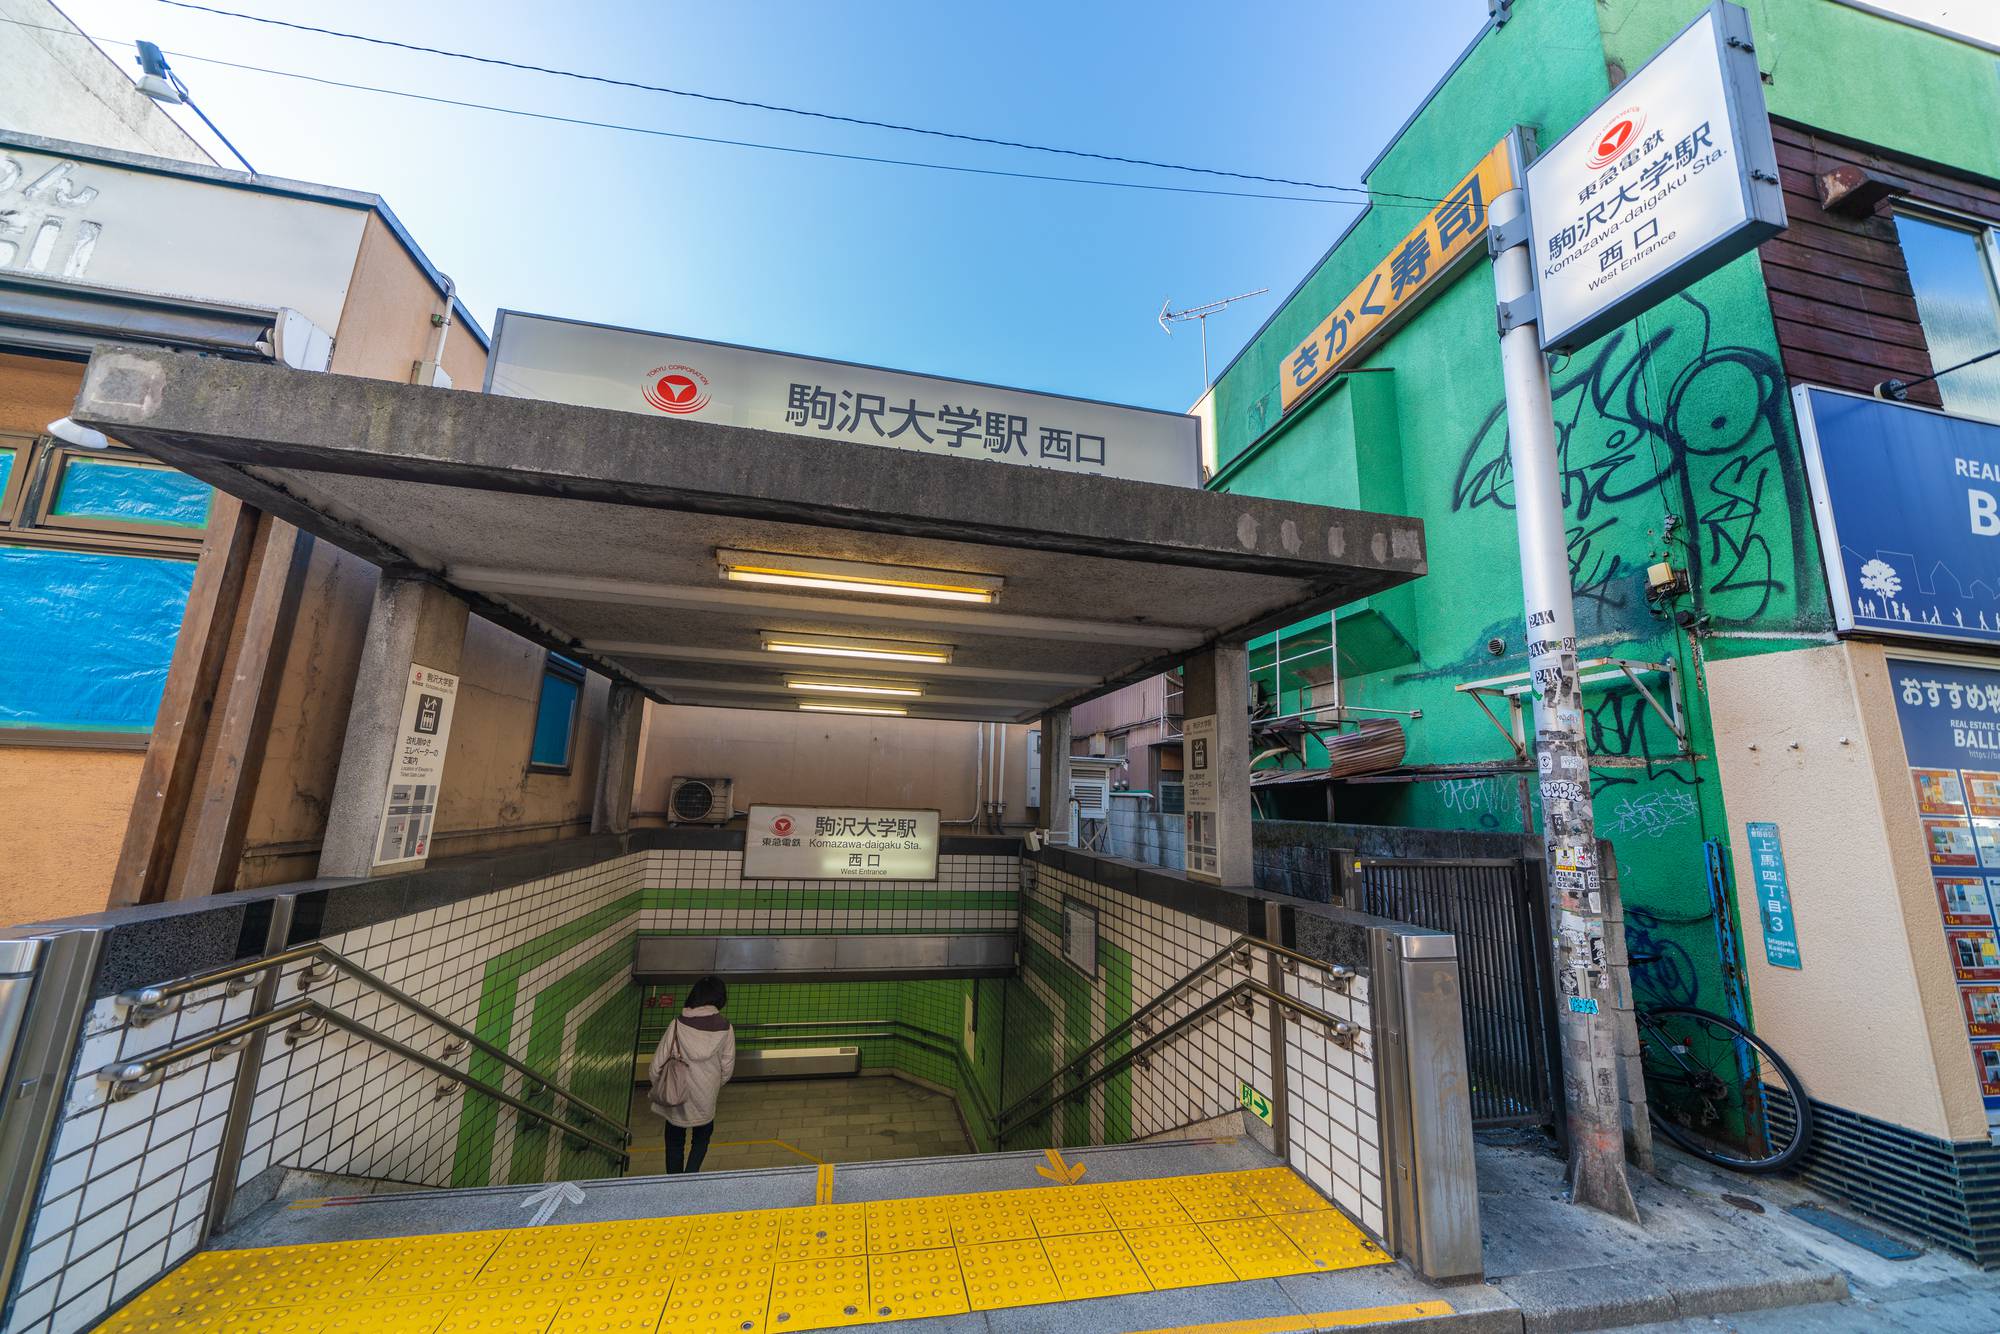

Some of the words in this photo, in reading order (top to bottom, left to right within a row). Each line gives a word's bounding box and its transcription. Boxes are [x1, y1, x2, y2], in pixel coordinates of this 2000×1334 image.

[1578, 129, 1665, 206] 東急電鉄
[1548, 121, 1713, 261] 駒沢大学駅
[1544, 174, 1688, 280] Komazawa-daigaku
[1693, 149, 1728, 176] Sta.
[1599, 218, 1659, 272] 西口
[1588, 262, 1624, 291] West
[1620, 230, 1677, 271] Entrance
[1292, 173, 1485, 387] きかく寿司
[646, 365, 667, 378] TOKYU
[785, 383, 1028, 457] 駒沢大学駅
[1039, 426, 1106, 466] 西口
[1530, 610, 1552, 628] 24K
[1536, 667, 1560, 684] 24K
[1969, 721, 1996, 731] ESTATE
[1953, 728, 2000, 751] BALL
[814, 816, 918, 839] 駒沢大学駅
[762, 837, 801, 848] 東急電鉄
[809, 838, 902, 852] Komazawa-daigaku
[903, 840, 922, 851] Sta.
[848, 853, 881, 867] 西口
[840, 868, 858, 876] West
[859, 868, 888, 876] Entrance
